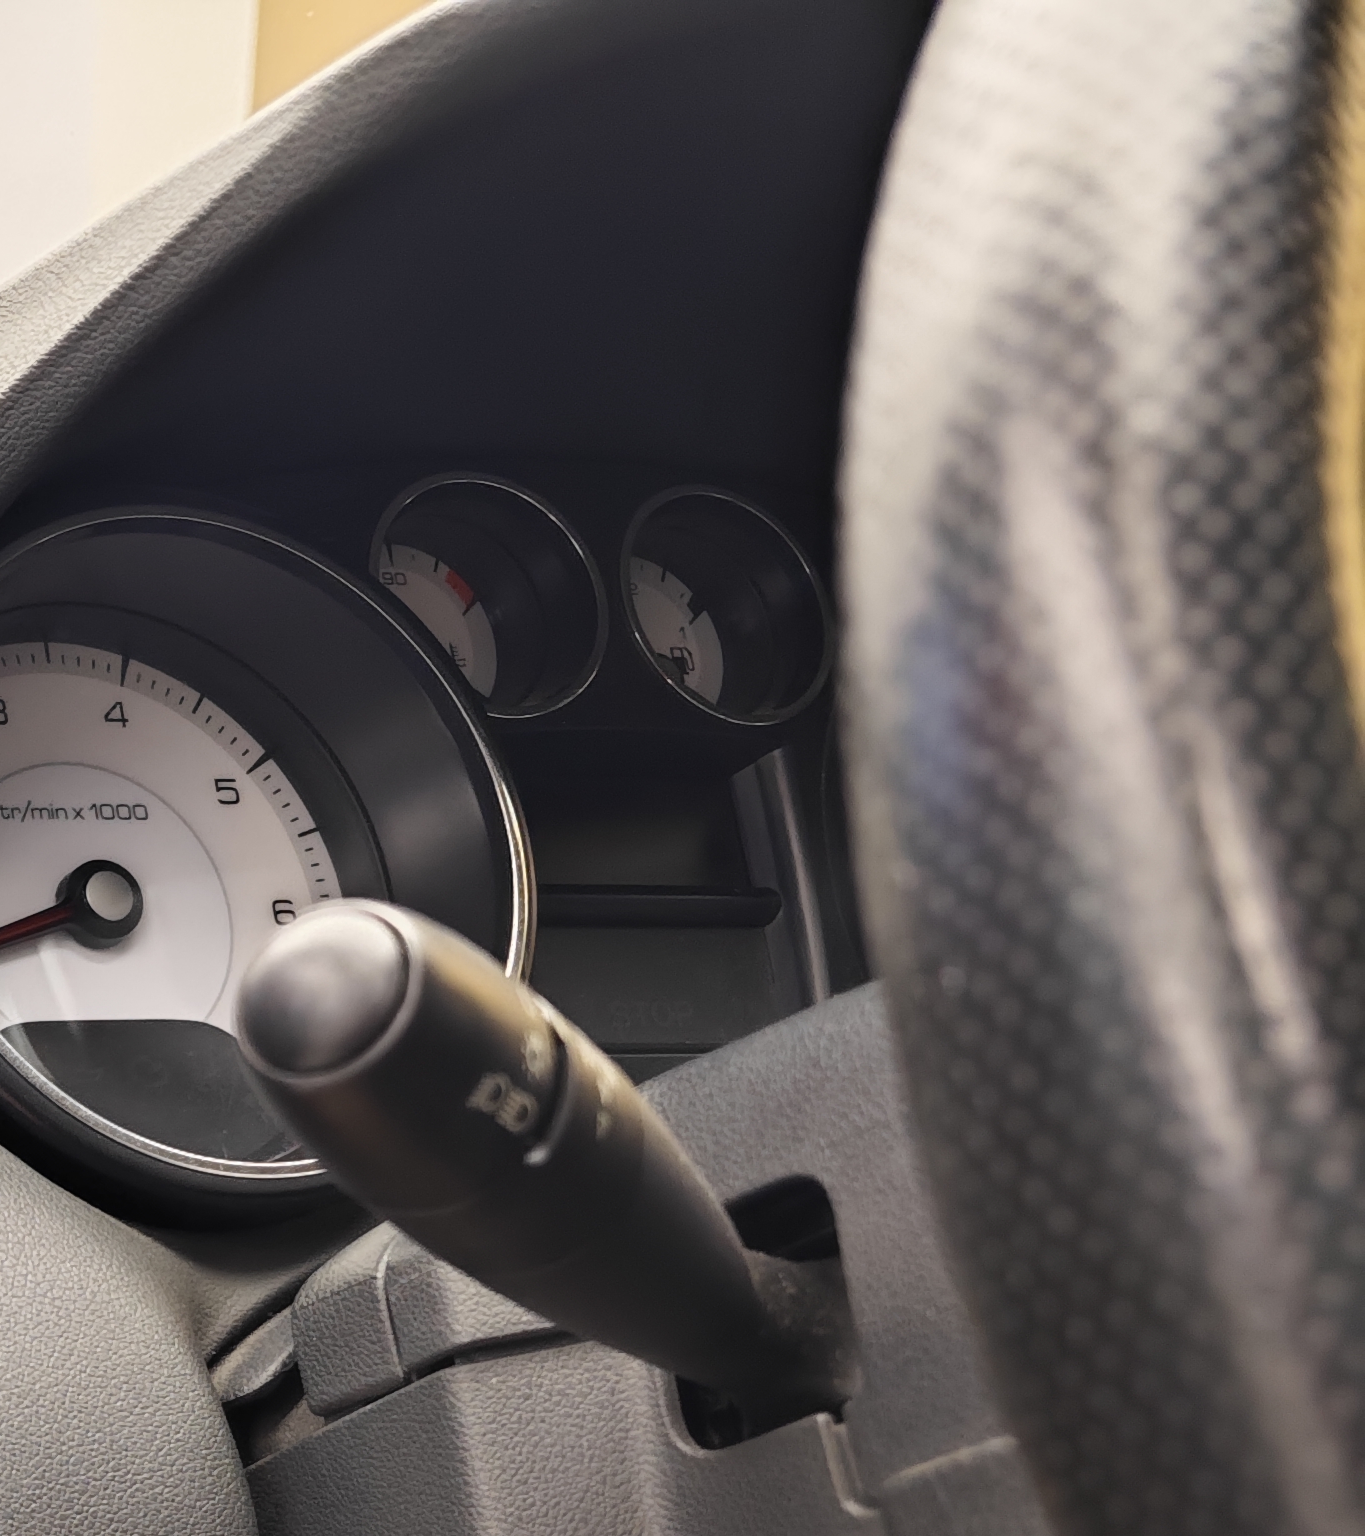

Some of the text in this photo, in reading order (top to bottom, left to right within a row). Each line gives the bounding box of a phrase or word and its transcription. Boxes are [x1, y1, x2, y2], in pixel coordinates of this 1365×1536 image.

[381, 571, 408, 586] 90
[104, 701, 129, 728] 4
[214, 778, 240, 805] 5
[0, 800, 69, 823] tr/min
[272, 899, 297, 926] 6
